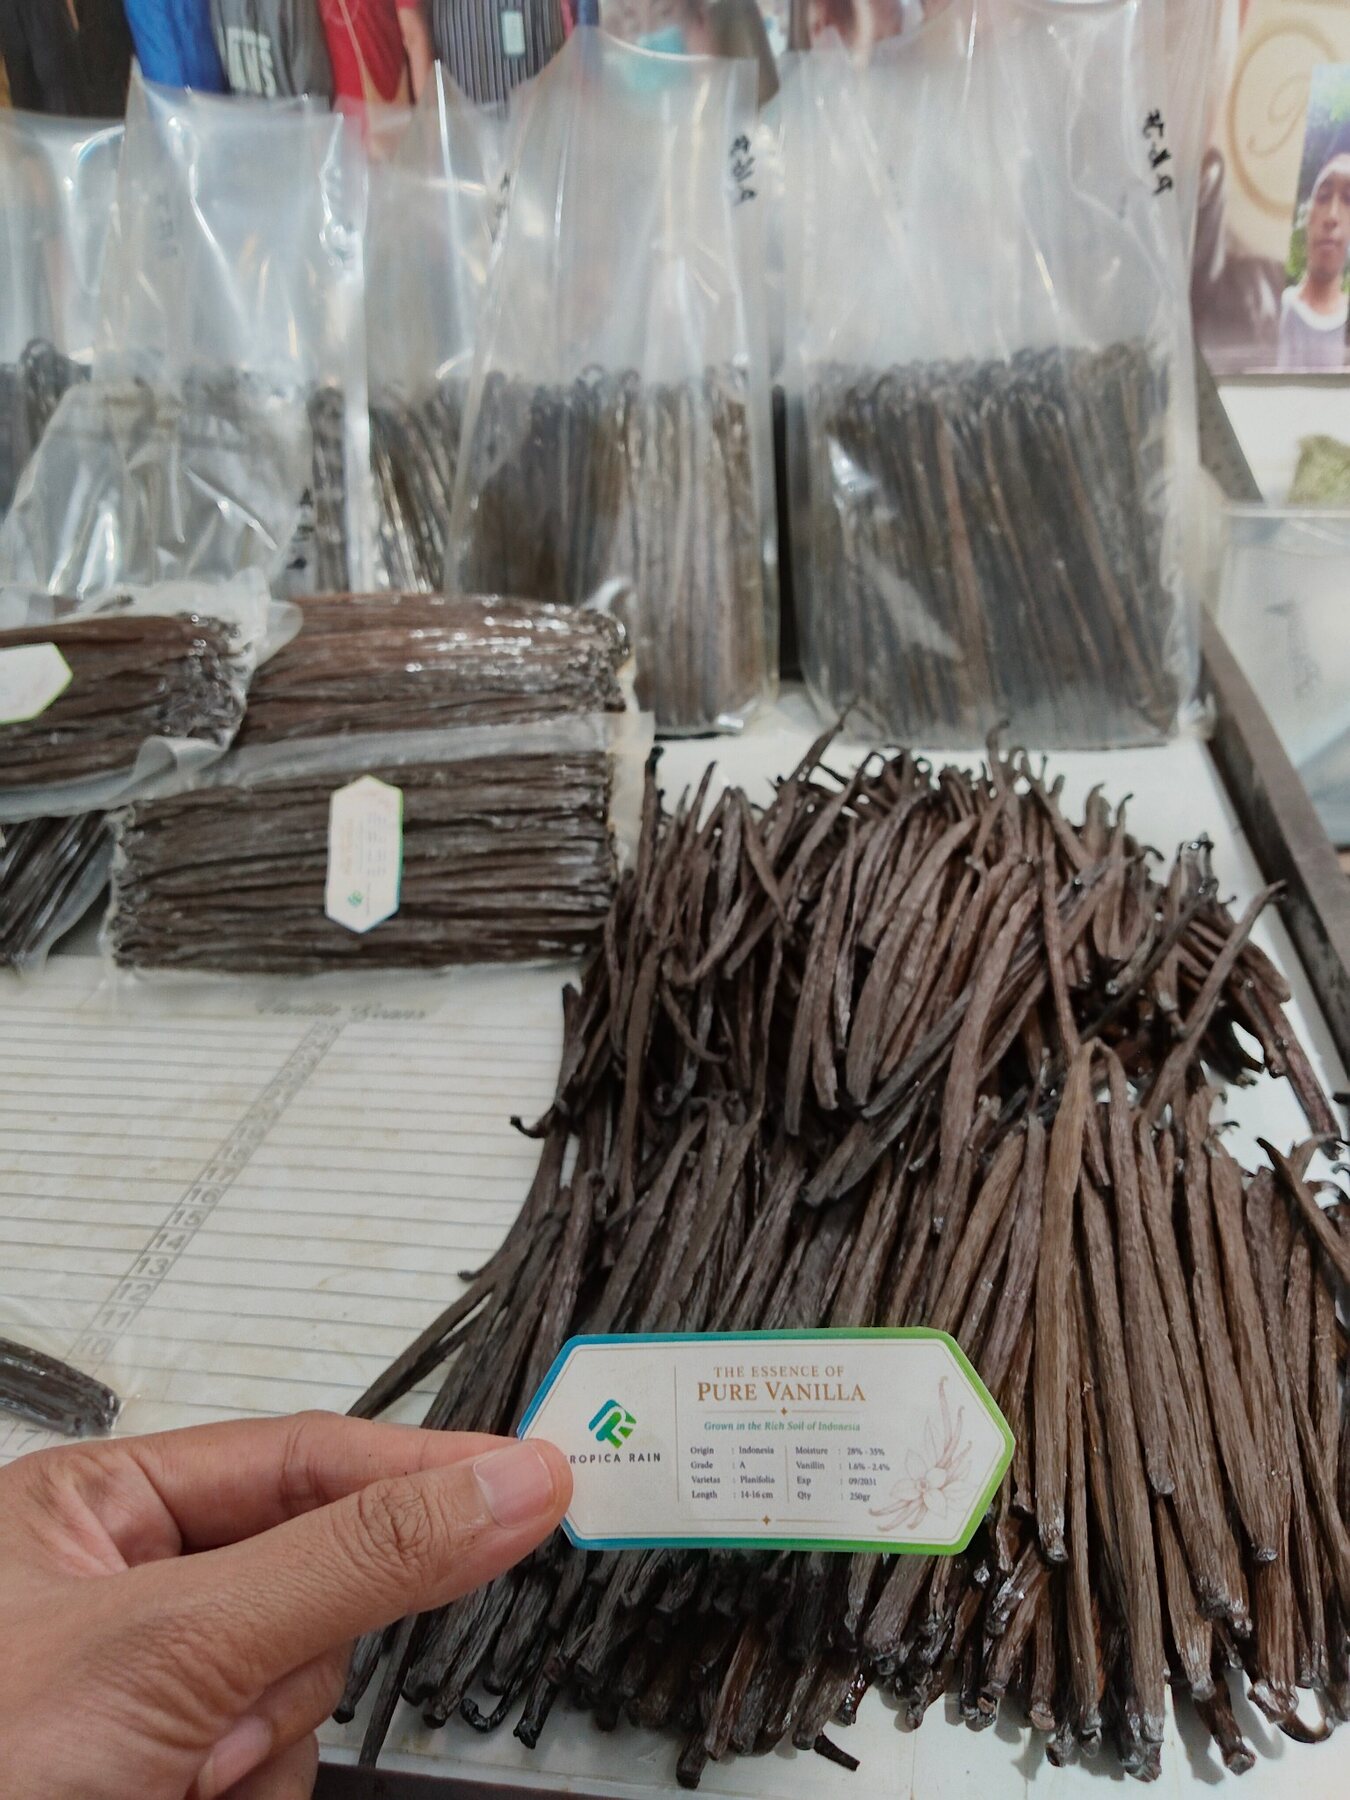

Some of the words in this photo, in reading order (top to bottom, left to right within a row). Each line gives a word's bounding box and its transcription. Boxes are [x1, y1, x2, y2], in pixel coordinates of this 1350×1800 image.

[206, 1166, 236, 1182] 17
[191, 1187, 222, 1204] 16
[173, 1209, 206, 1227] 15
[156, 1233, 186, 1251] 14
[137, 1256, 169, 1276] 13
[118, 1282, 152, 1302] 12
[102, 1309, 131, 1328] 11
[80, 1337, 111, 1355] 10
[713, 1366, 745, 1378] THE
[751, 1365, 819, 1378] ESSENCE
[825, 1365, 844, 1377] OF
[697, 1381, 758, 1401] PURE
[765, 1381, 867, 1401] VANILLA
[704, 1421, 734, 1431] Grown
[736, 1421, 745, 1431] in
[748, 1421, 762, 1431] the
[764, 1421, 785, 1431] Rich
[787, 1421, 805, 1431] Soil
[806, 1421, 816, 1432] of
[818, 1421, 861, 1432] Indonesia
[690, 1446, 715, 1456] Origin
[739, 1446, 775, 1455] Indonesia
[795, 1446, 829, 1455] Moisture
[847, 1447, 863, 1456] 28%
[566, 1453, 622, 1464] ROPICA
[628, 1452, 662, 1463] RAIN
[690, 1461, 714, 1470] Grade
[739, 1461, 746, 1470] A
[796, 1461, 825, 1471] Vanillin
[848, 1462, 866, 1471] 1.6%
[872, 1463, 890, 1472] 2.4%
[691, 1476, 721, 1485] Varietas
[740, 1475, 775, 1485] Planifolia
[797, 1476, 812, 1486] Exp
[691, 1491, 718, 1501] Length
[741, 1491, 761, 1500] 14-16
[797, 1491, 812, 1501] Qty
[850, 1492, 871, 1502] 250gr
